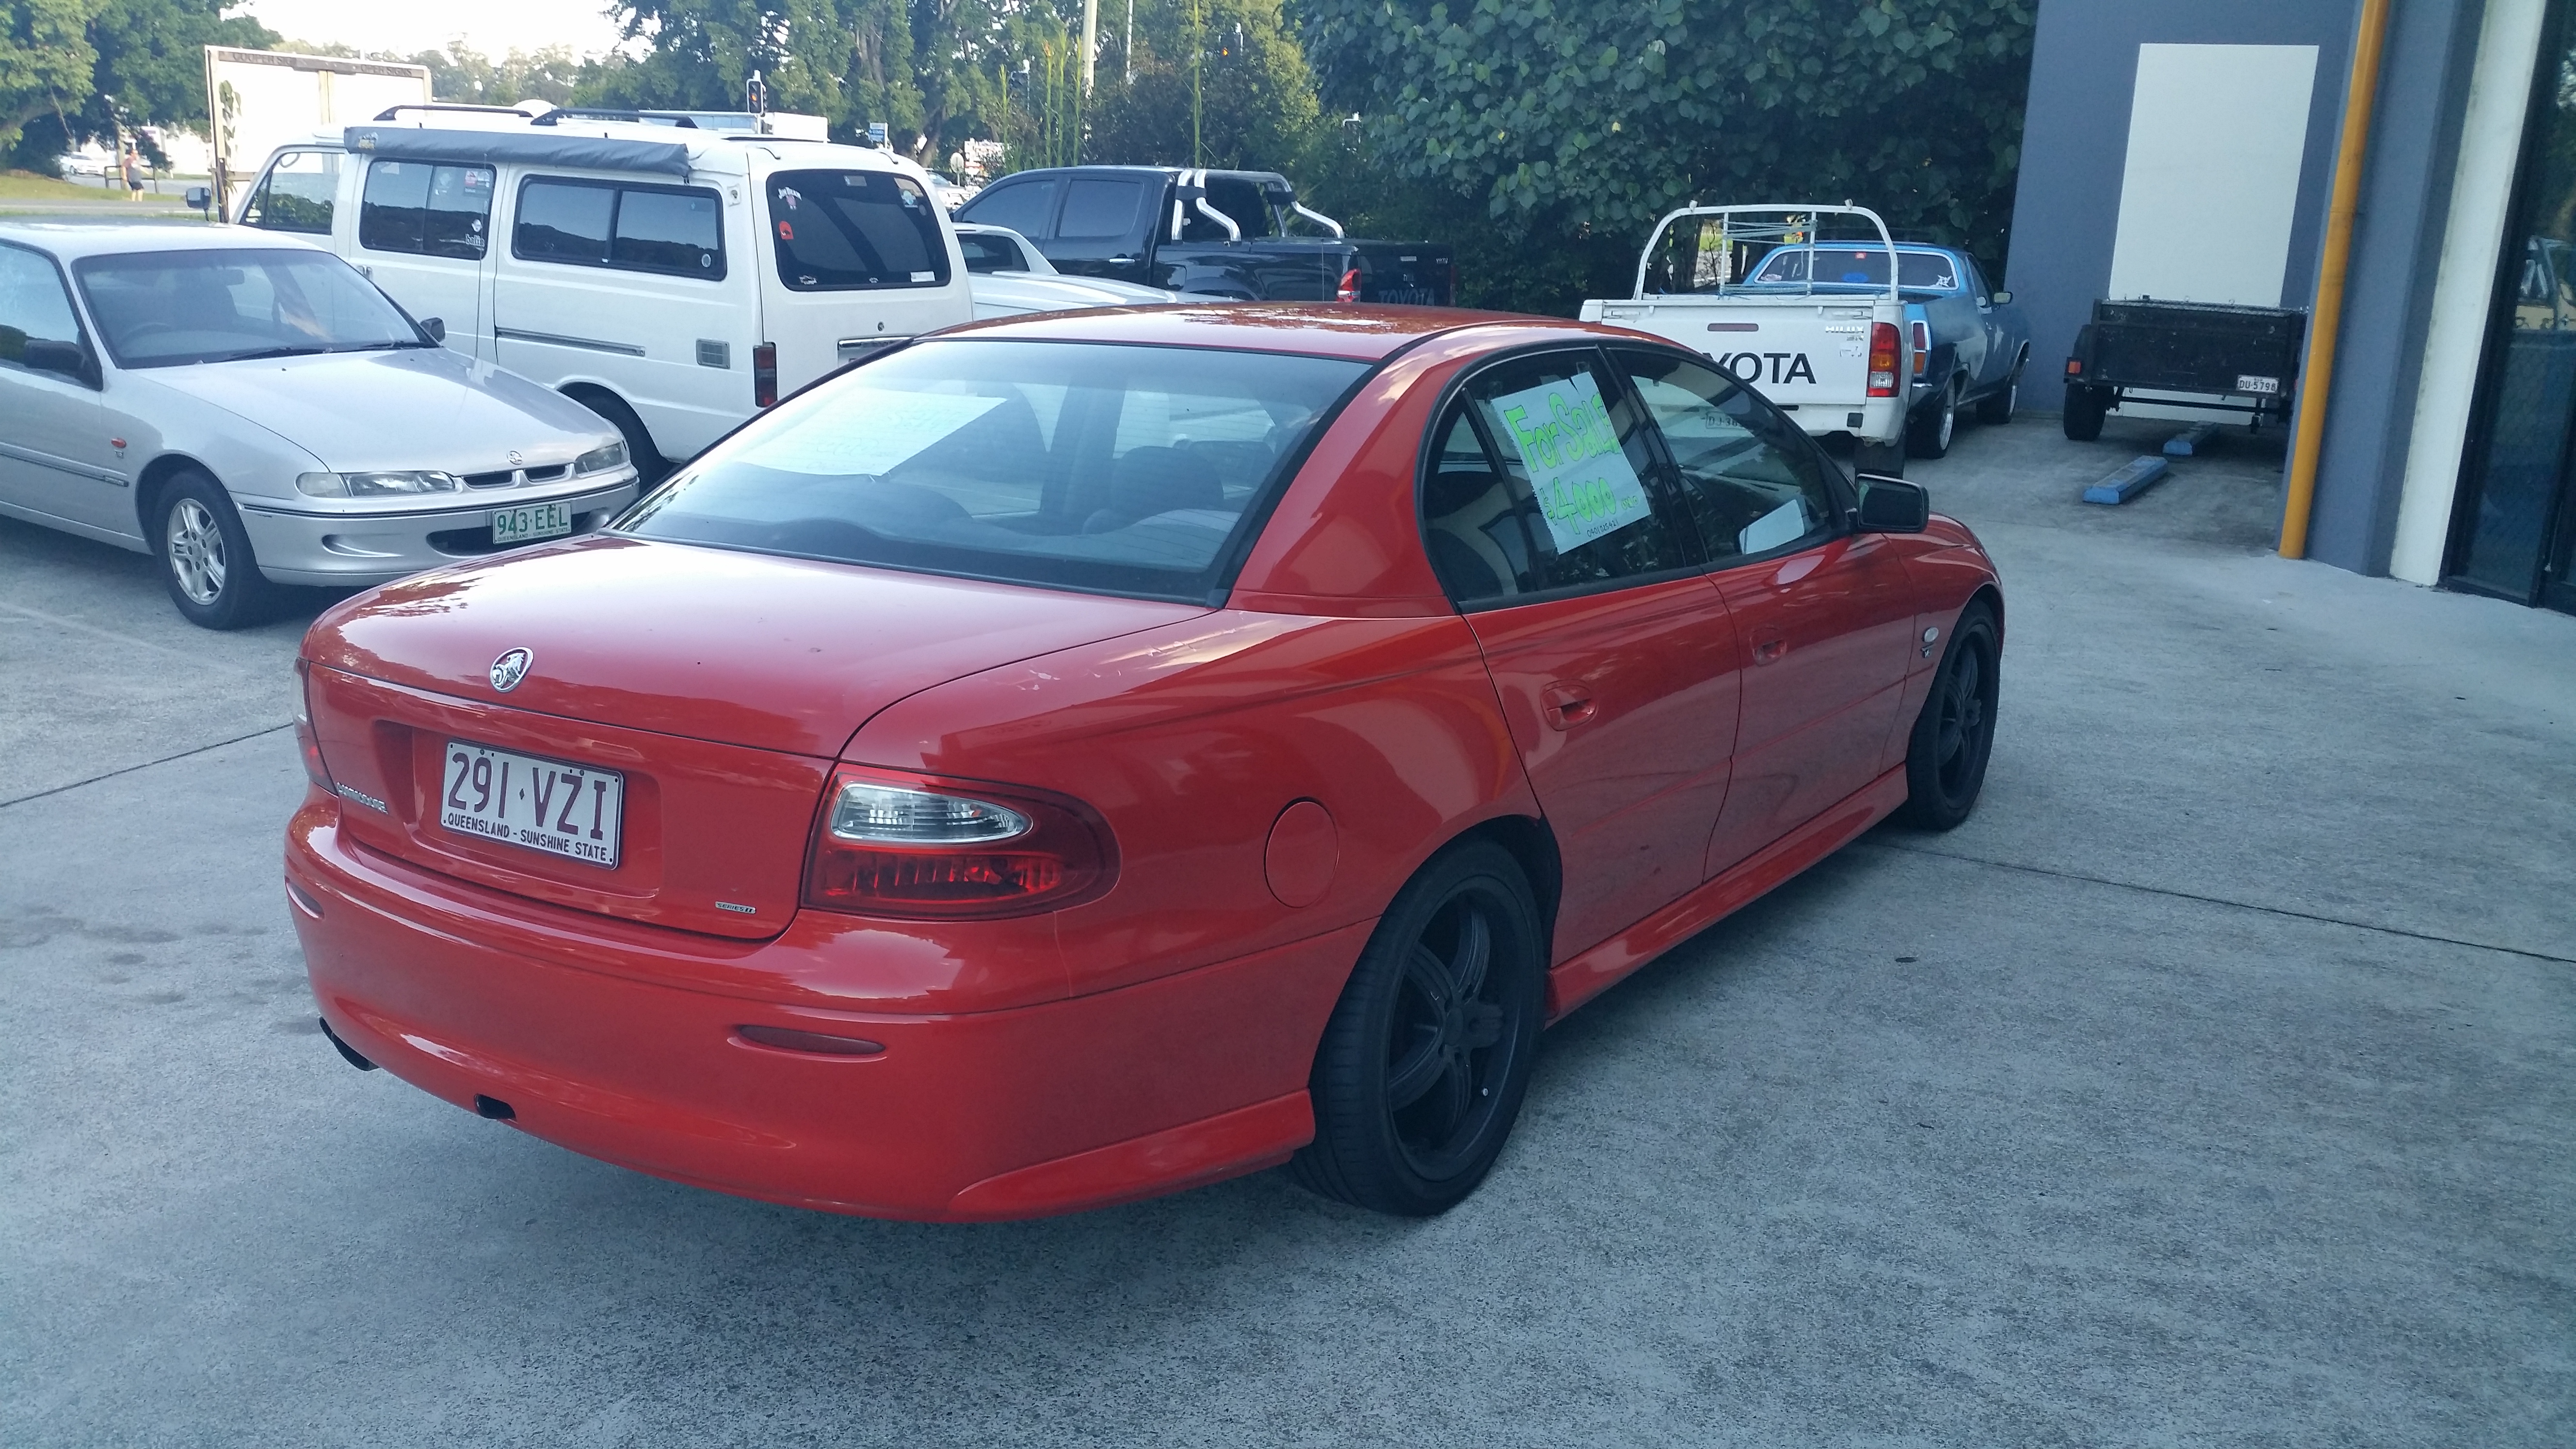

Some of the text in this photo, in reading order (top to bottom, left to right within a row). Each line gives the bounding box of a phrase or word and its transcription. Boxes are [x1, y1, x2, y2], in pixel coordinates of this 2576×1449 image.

[1378, 288, 1435, 306] TOYOTA
[1504, 404, 1563, 473] For
[1539, 477, 1616, 535] $4000
[448, 813, 510, 838] QUEENSLAND
[520, 829, 570, 853] SUNSHINE
[575, 842, 607, 861] STATE
[718, 903, 744, 912] SERIES
